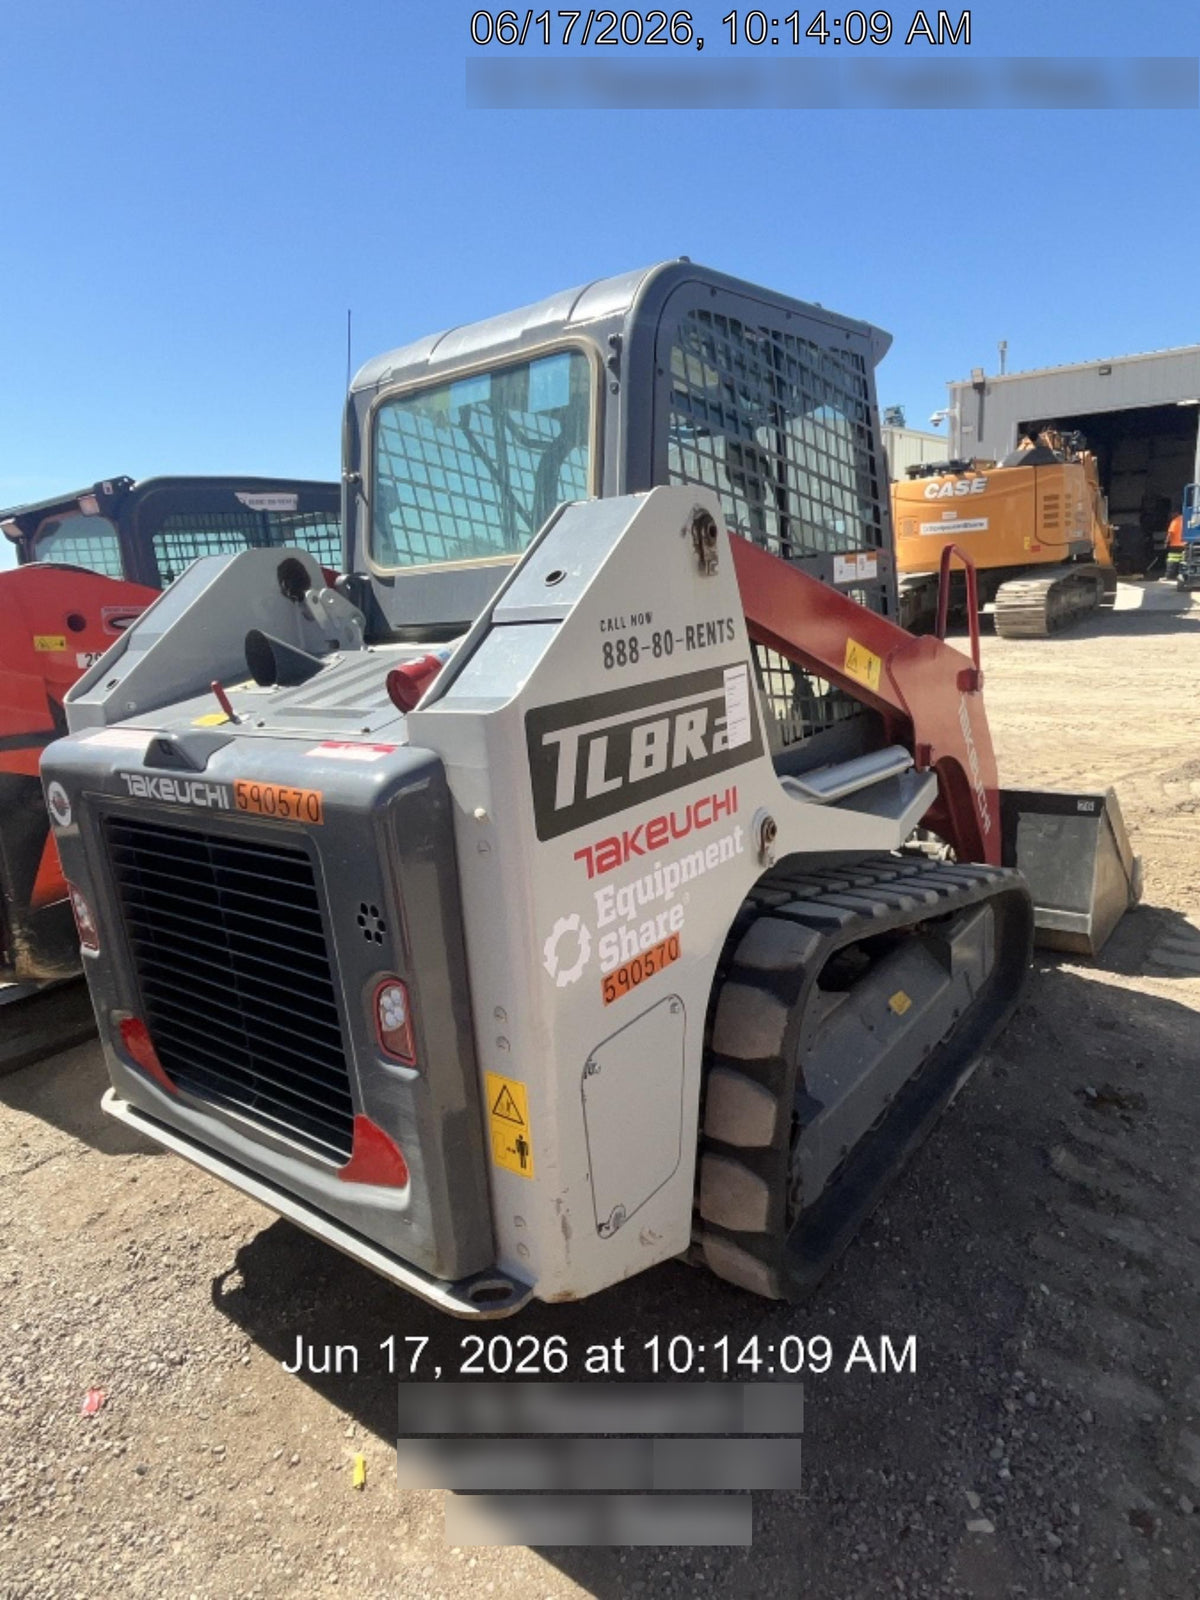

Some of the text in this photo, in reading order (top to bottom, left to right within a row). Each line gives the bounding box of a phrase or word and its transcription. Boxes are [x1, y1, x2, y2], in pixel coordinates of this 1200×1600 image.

[924, 477, 988, 499] CASE
[600, 611, 653, 632] CALL NOW
[602, 617, 736, 669] 888-80-RENTS
[120, 772, 230, 810] TAKEUCHI
[235, 782, 321, 823] 590570
[573, 785, 739, 880] TAKEUCHI
[593, 825, 744, 928] Equipment
[599, 903, 685, 973] Share
[603, 935, 679, 1004] 590570
